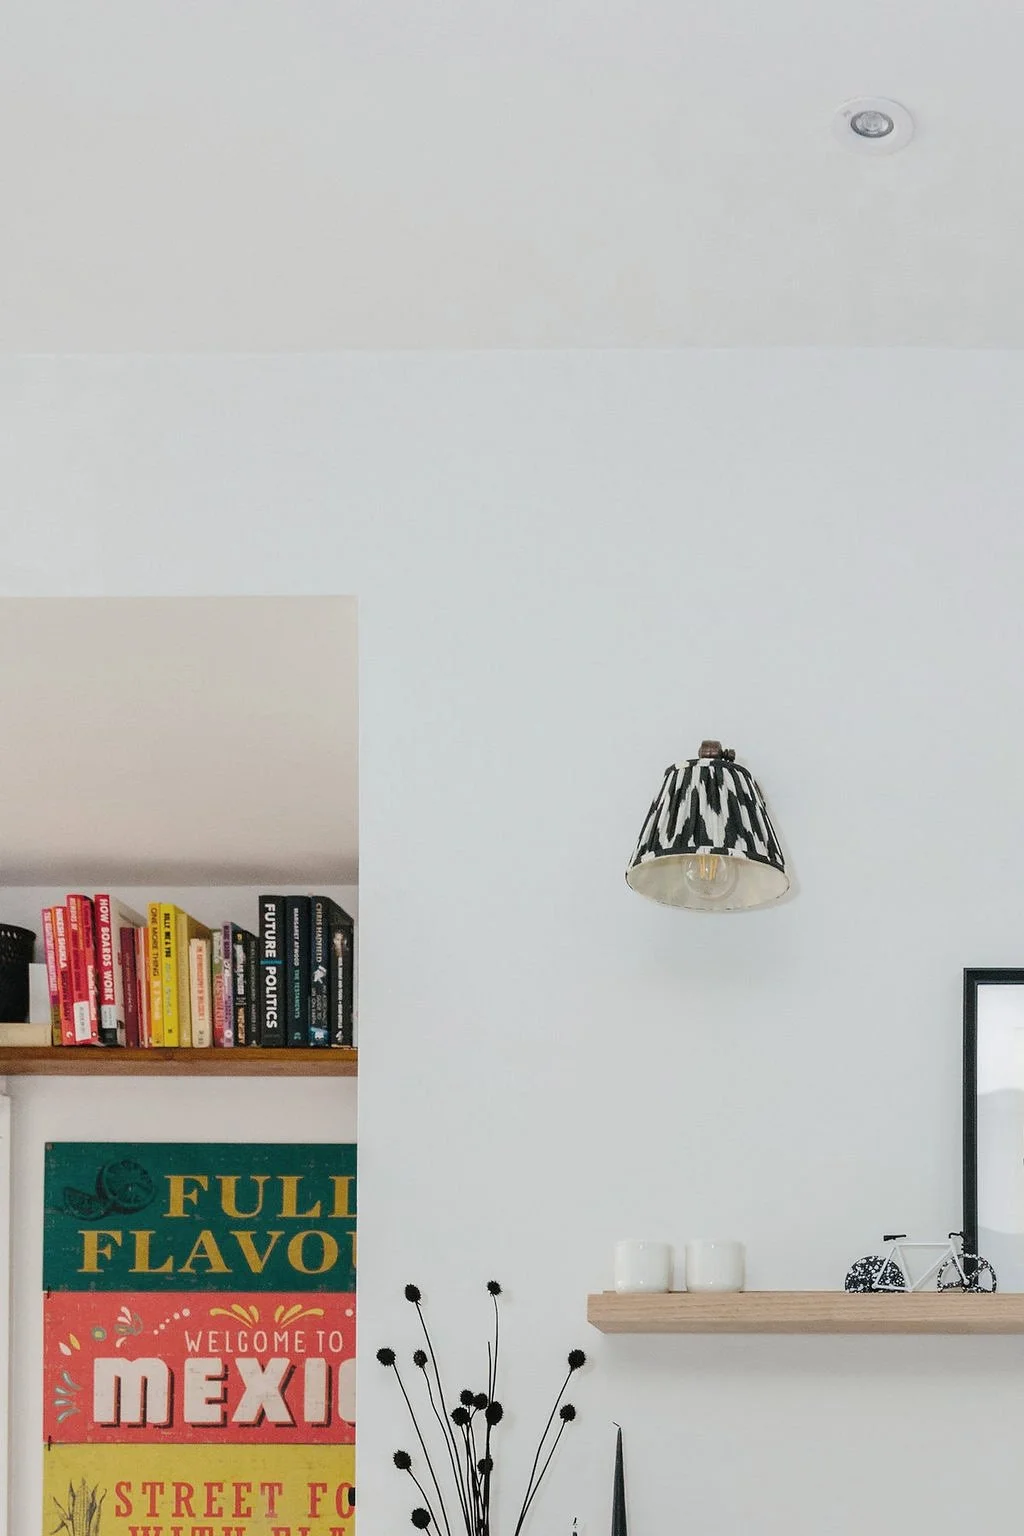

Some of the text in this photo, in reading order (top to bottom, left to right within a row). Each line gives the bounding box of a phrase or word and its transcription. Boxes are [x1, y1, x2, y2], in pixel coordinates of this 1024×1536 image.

[99, 898, 109, 923] HOW
[315, 903, 323, 926] CHRIS
[151, 927, 159, 950] MORE
[264, 903, 276, 958] FUTURE
[101, 926, 112, 967] BOARDS
[152, 952, 160, 977] THING
[103, 970, 114, 1001] WORK
[265, 966, 278, 1029] POLITICS
[77, 1229, 357, 1274] FLAVO
[185, 1330, 344, 1353] WELCOME TO
[115, 1481, 283, 1518] STREET
